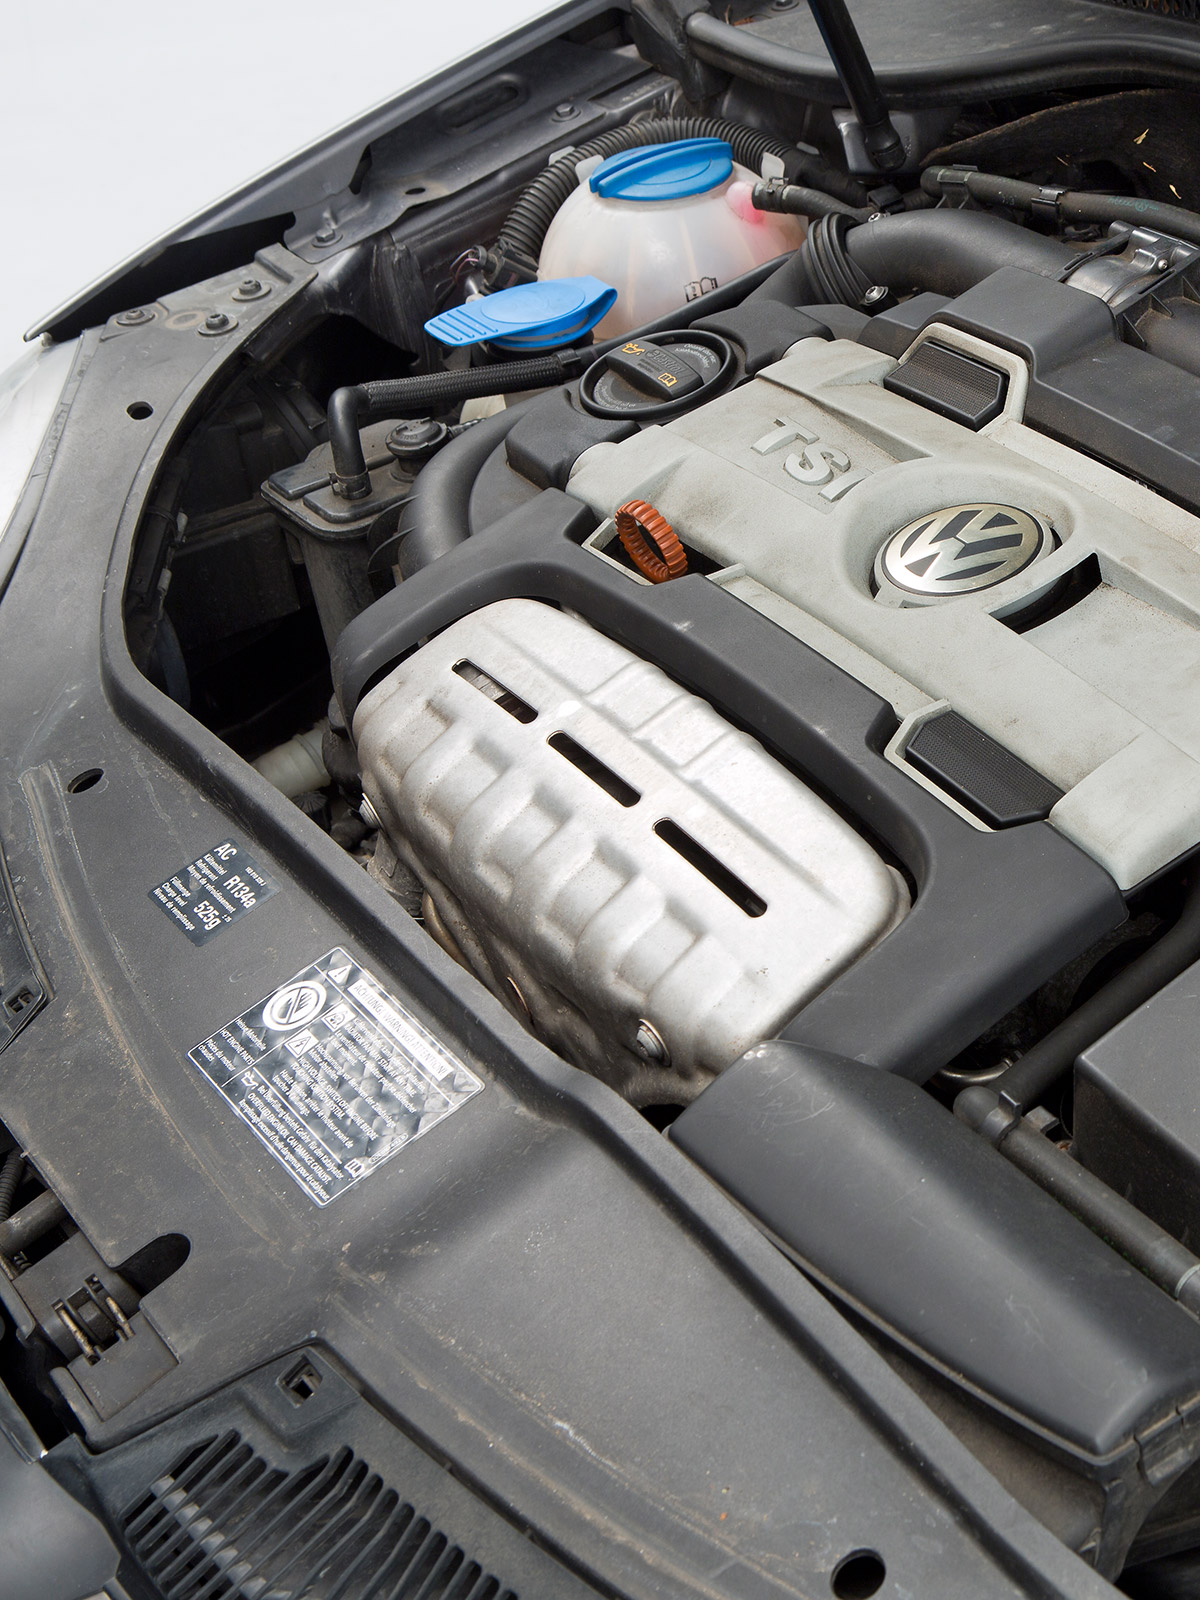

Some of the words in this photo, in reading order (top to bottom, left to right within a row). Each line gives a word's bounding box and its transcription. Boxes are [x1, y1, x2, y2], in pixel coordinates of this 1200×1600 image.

[750, 416, 871, 503] TSI
[214, 843, 237, 860] AC
[195, 859, 218, 881] Refrigerant
[162, 882, 177, 897] Charge
[174, 895, 187, 907] level
[187, 865, 202, 880] Moyen
[204, 883, 236, 913] refroidissement
[223, 875, 256, 908] R134a
[153, 888, 168, 903] Niveau
[171, 907, 195, 930] remplissage
[194, 900, 224, 930] 525g
[245, 1029, 266, 1051] Motorteile
[335, 1030, 342, 1038] Le
[343, 1023, 366, 1044] RADIATOR
[220, 1029, 231, 1039] HOT
[227, 1036, 244, 1053] ENGINE
[240, 1051, 255, 1065] PARTS
[330, 1038, 342, 1049] tout
[337, 1035, 362, 1058] ventilateur
[361, 1041, 374, 1052] FAN
[381, 1046, 395, 1058] kann
[383, 1015, 415, 1043] WARNING!
[411, 1041, 447, 1075] ATTENTION!
[198, 1045, 215, 1061] chaudes
[308, 1049, 322, 1063] Motor
[369, 1049, 382, 1061] MAY
[220, 1056, 236, 1071] moteur
[378, 1059, 394, 1072] START
[280, 1069, 293, 1084] Haute
[389, 1069, 400, 1077] AT
[394, 1075, 406, 1086] ANY
[272, 1075, 289, 1092] toucher
[290, 1062, 314, 1085] TOUCHING
[310, 1082, 331, 1105] IGNITION
[325, 1100, 345, 1120] SYSTEM.
[343, 1072, 352, 1080] vor
[365, 1097, 375, 1105] der
[378, 1077, 394, 1090] peut
[402, 1083, 417, 1097] TIME.
[298, 1056, 312, 1070] HIGH
[323, 1085, 343, 1103] SWITCH
[339, 1100, 351, 1109] OFF
[346, 1107, 364, 1126] ENGINE
[360, 1123, 378, 1140] BEFORE
[257, 1085, 267, 1094] Bei
[283, 1113, 300, 1131] besteht
[296, 1128, 311, 1143] Gefahr
[308, 1141, 317, 1150] für
[314, 1148, 324, 1158] den
[317, 1109, 326, 1117] le
[321, 1114, 338, 1131] moteur
[238, 1099, 263, 1123] Remplissage
[257, 1121, 275, 1137] excessif
[296, 1166, 309, 1177] pour
[248, 1093, 271, 1117] OVERFILLED
[266, 1114, 284, 1132] ENGINE
[279, 1129, 290, 1138] OIL
[287, 1136, 299, 1147] CAN
[294, 1144, 315, 1165] DAMAGE
[310, 1162, 332, 1184] CATALYST.
[334, 1130, 349, 1143] avant
